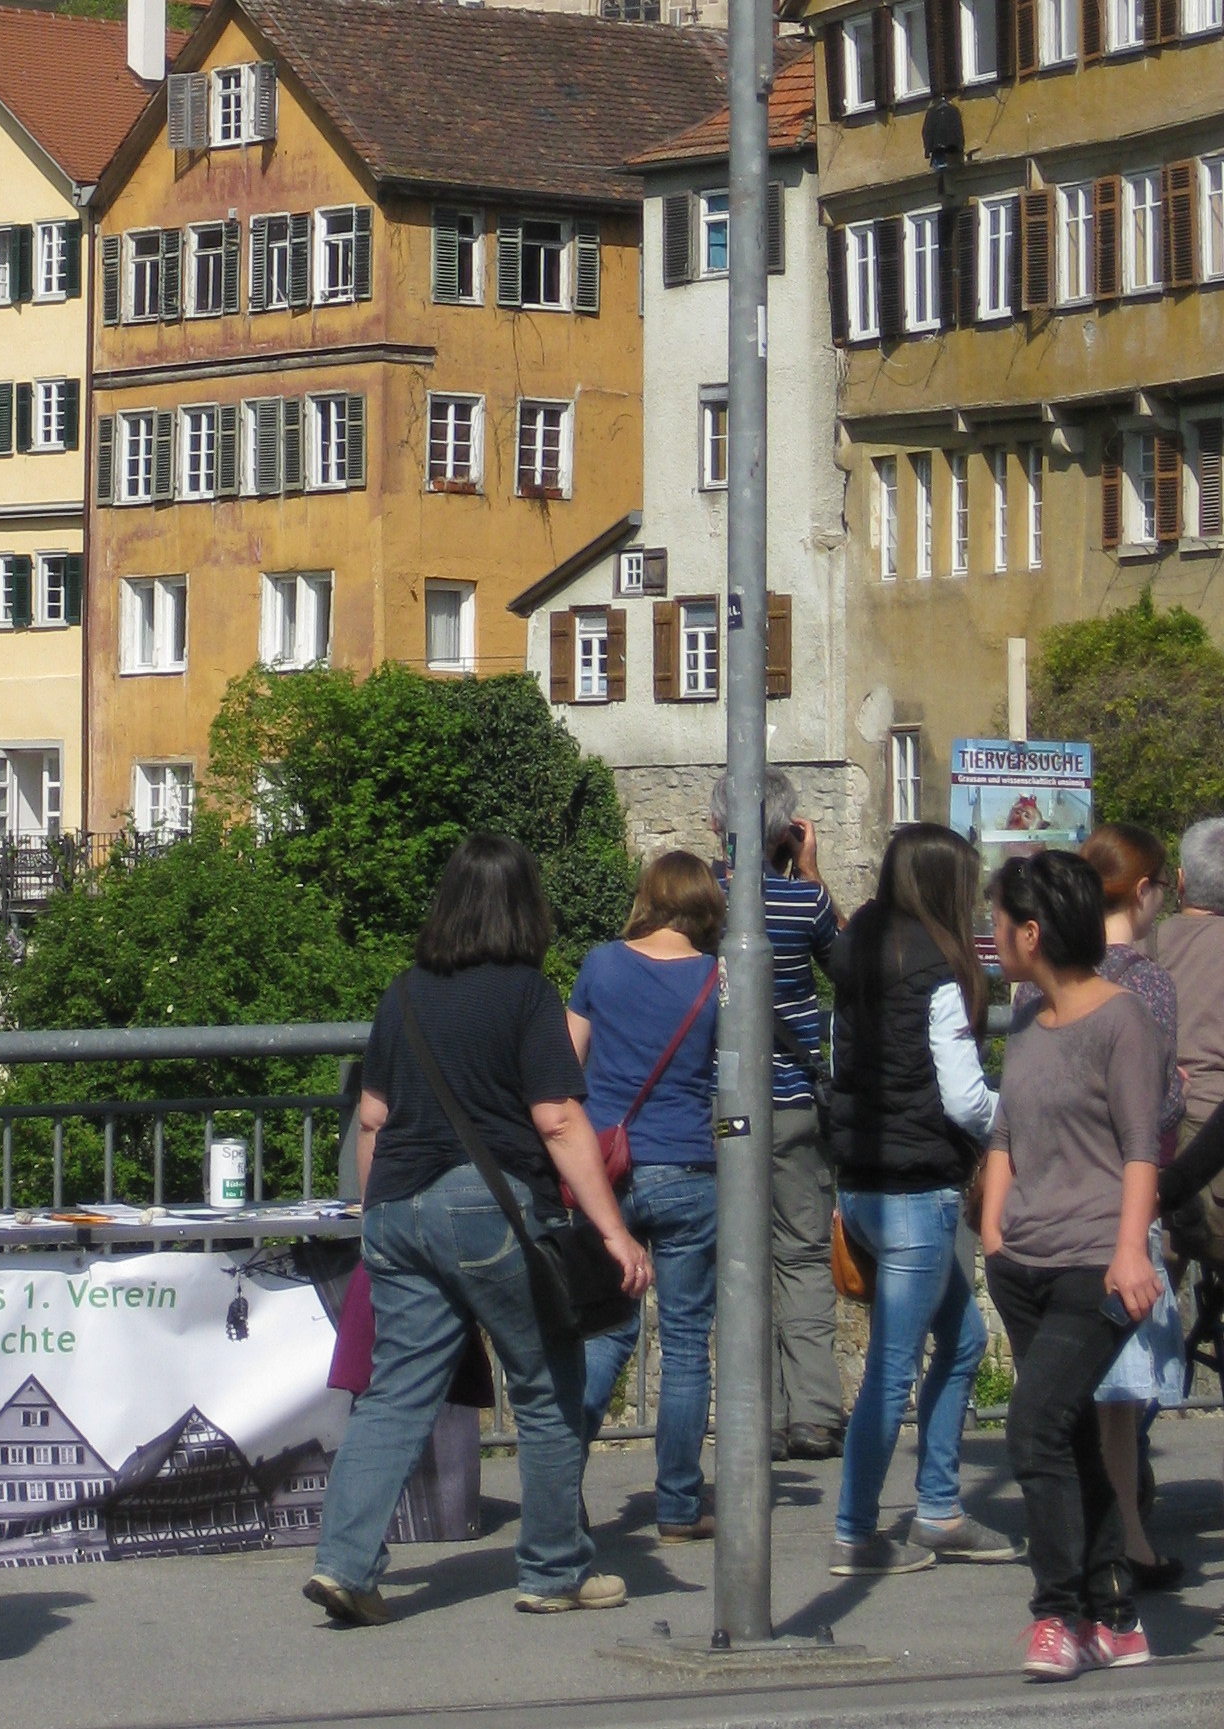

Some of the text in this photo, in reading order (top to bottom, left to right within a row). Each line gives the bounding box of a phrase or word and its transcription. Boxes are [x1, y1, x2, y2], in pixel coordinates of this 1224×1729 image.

[959, 750, 1085, 773] TIERVERSUCHE
[957, 774, 1086, 788] Grausam und wissenschaftlich unsinnig
[23, 1280, 50, 1310] 1.
[66, 1279, 177, 1309] Verein
